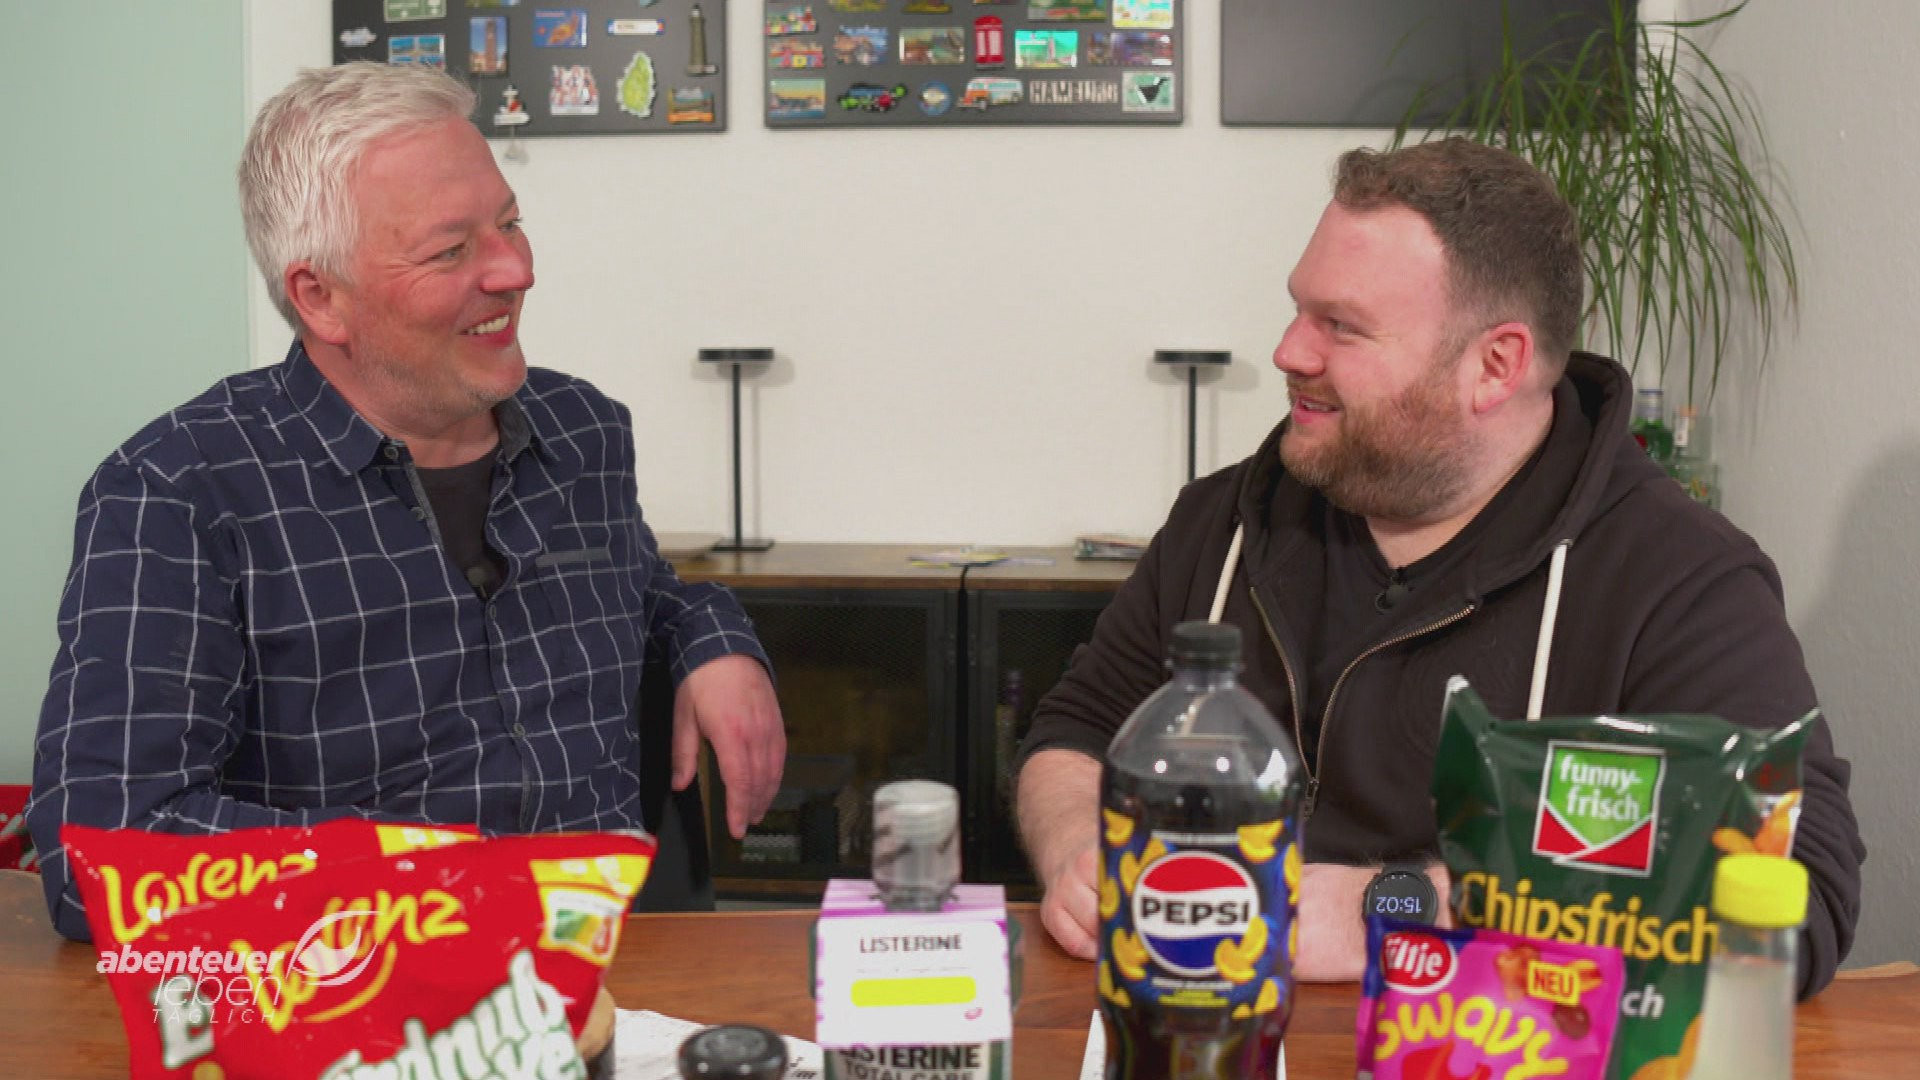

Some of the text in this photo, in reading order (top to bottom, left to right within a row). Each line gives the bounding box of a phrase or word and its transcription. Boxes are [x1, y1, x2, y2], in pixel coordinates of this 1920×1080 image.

[1559, 755, 1642, 791] funny-
[1566, 787, 1642, 823] frisch
[1140, 896, 1250, 926] PEPSI
[1375, 895, 1423, 915] 15:02
[1461, 871, 1720, 965] Chipsfrisch
[859, 933, 963, 954] LISTERINE
[1534, 965, 1575, 998] NEU
[839, 1044, 983, 1070] STERINE
